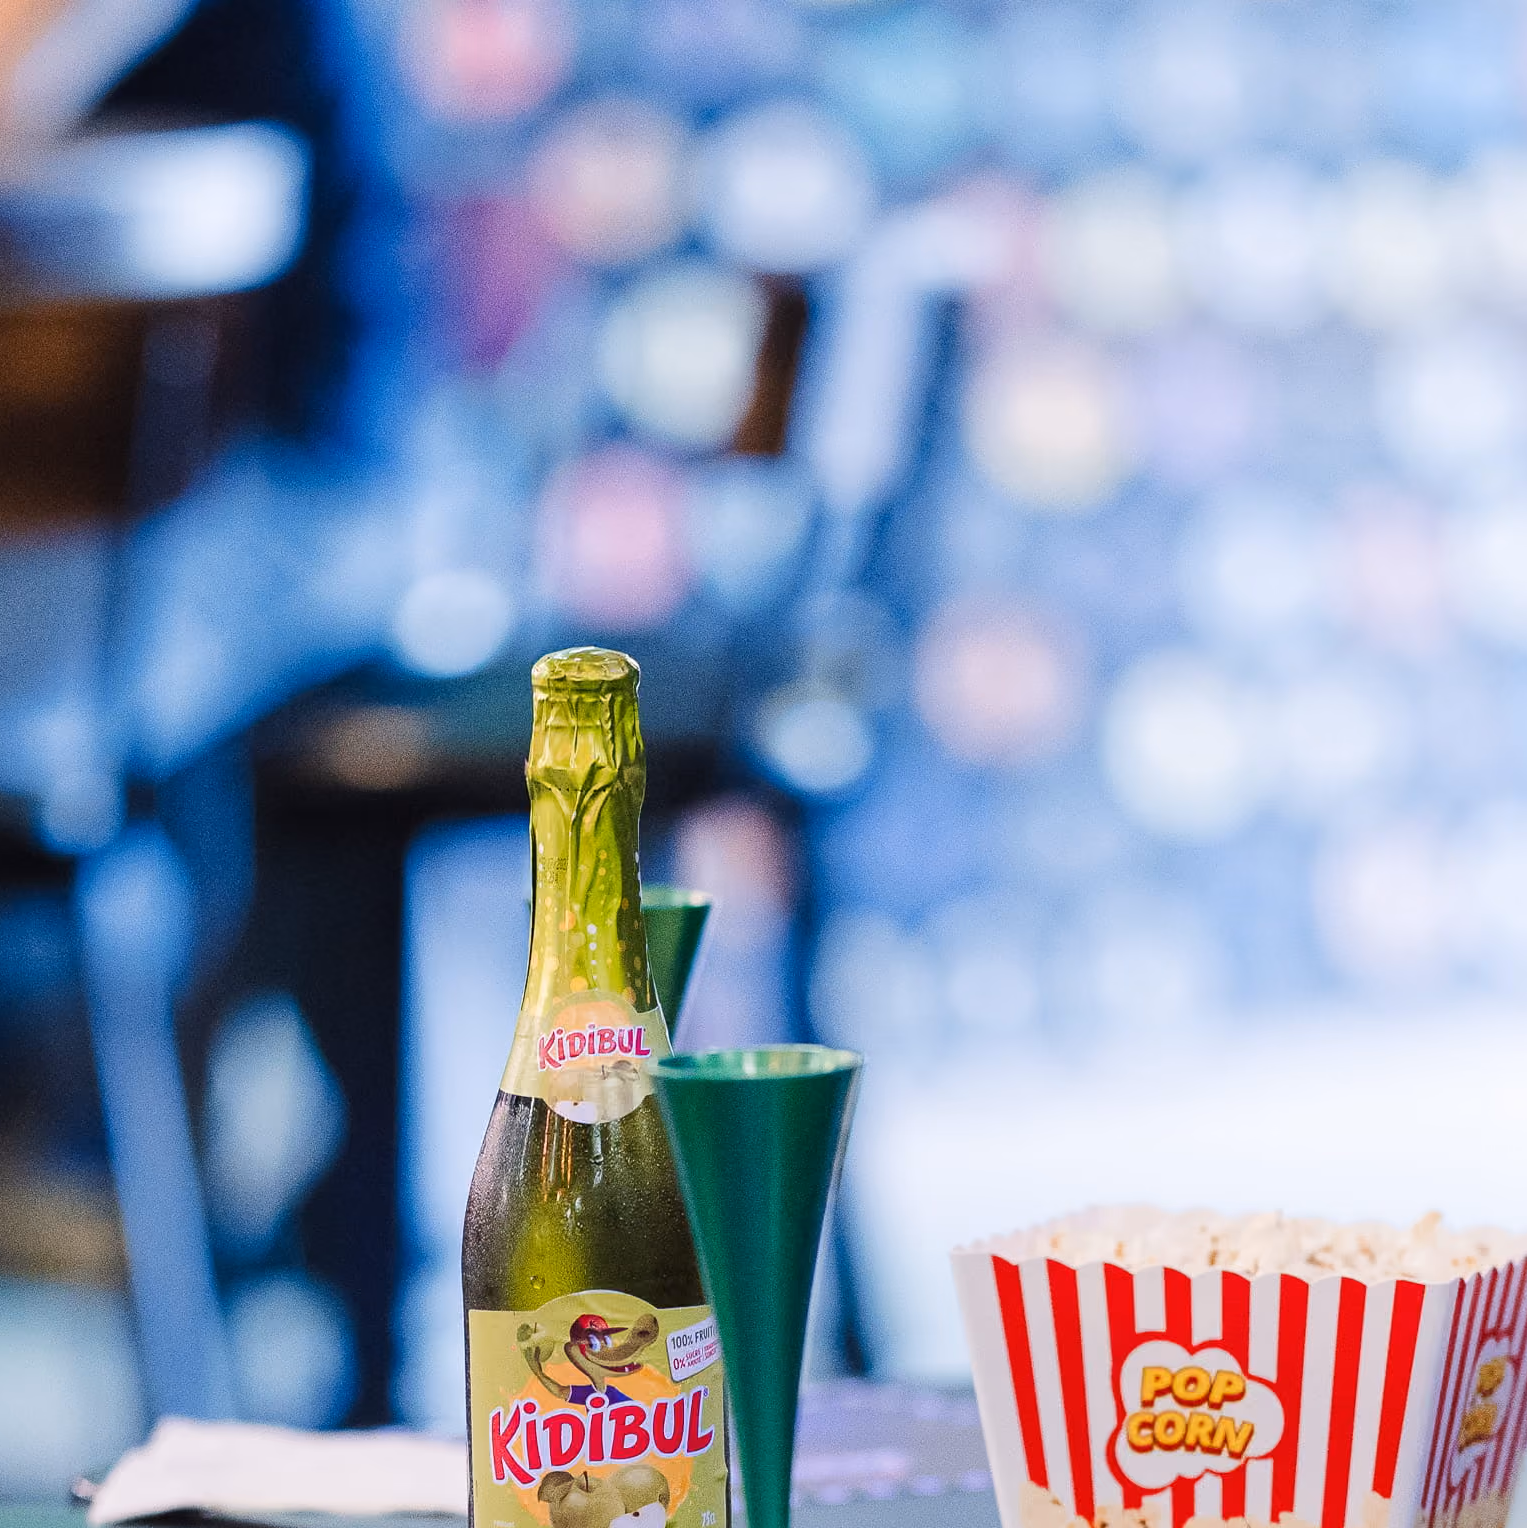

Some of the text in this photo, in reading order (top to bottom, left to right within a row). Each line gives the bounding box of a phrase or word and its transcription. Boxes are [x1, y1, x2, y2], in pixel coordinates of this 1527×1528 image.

[671, 1334, 693, 1350] 100%
[673, 1357, 686, 1370] 0%
[1140, 1366, 1247, 1408] POP
[1127, 1411, 1254, 1459] CORN
